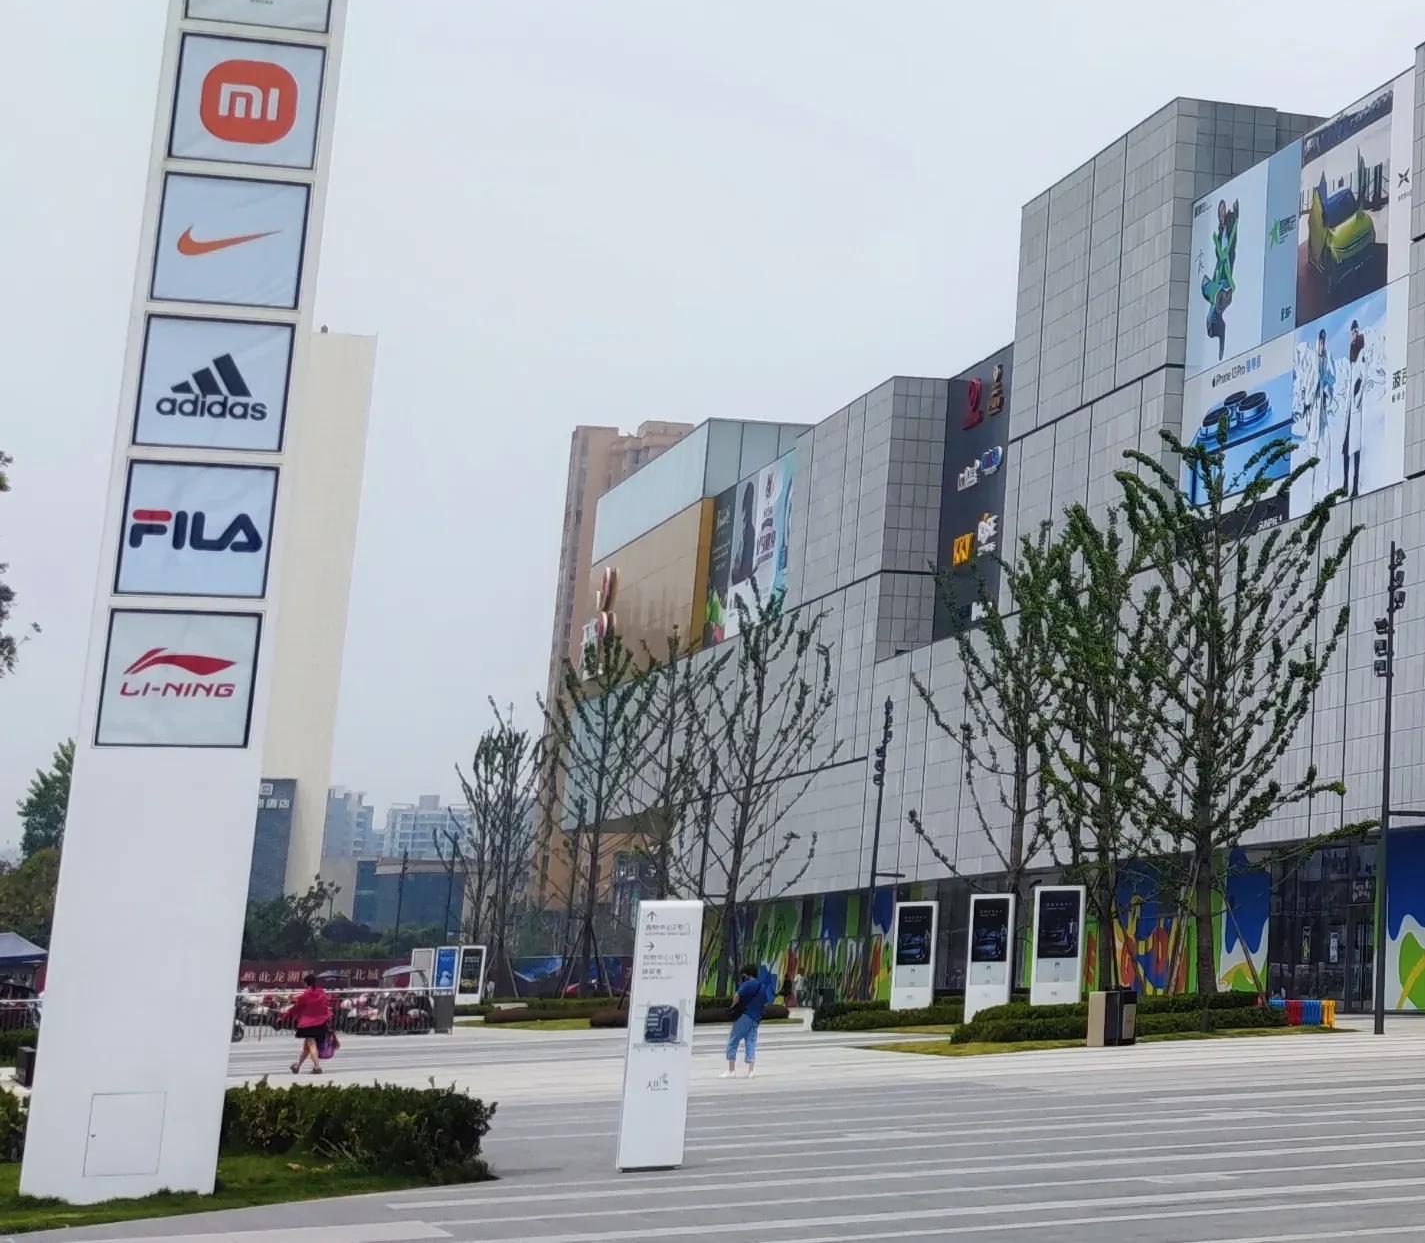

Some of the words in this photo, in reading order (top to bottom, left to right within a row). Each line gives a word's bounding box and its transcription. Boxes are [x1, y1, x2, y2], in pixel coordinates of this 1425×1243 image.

[156, 394, 267, 421] adidas
[129, 509, 263, 553] FILA
[120, 681, 236, 698] LI-NING
